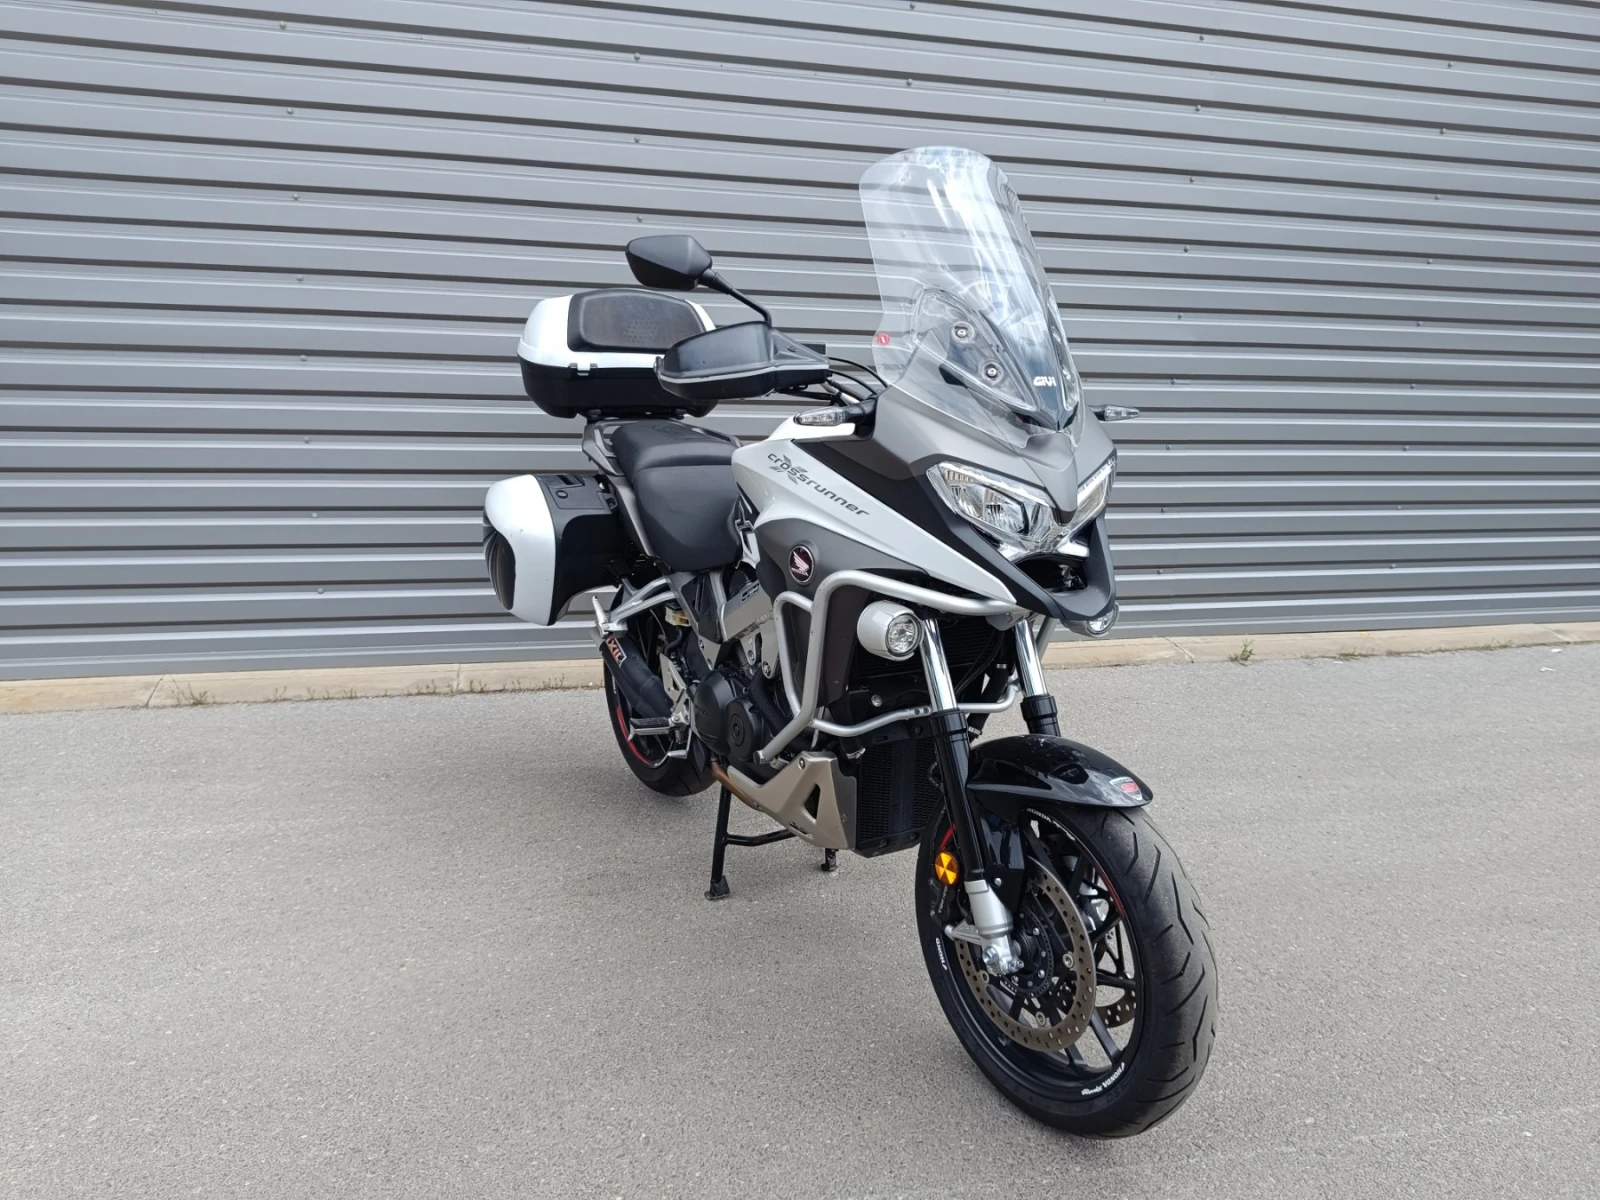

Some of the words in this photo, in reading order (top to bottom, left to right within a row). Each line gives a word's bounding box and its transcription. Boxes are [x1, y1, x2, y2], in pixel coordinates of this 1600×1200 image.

[1033, 375, 1057, 387] GIVI
[767, 453, 870, 516] crossrunner
[1102, 1066, 1122, 1088] HONDA
